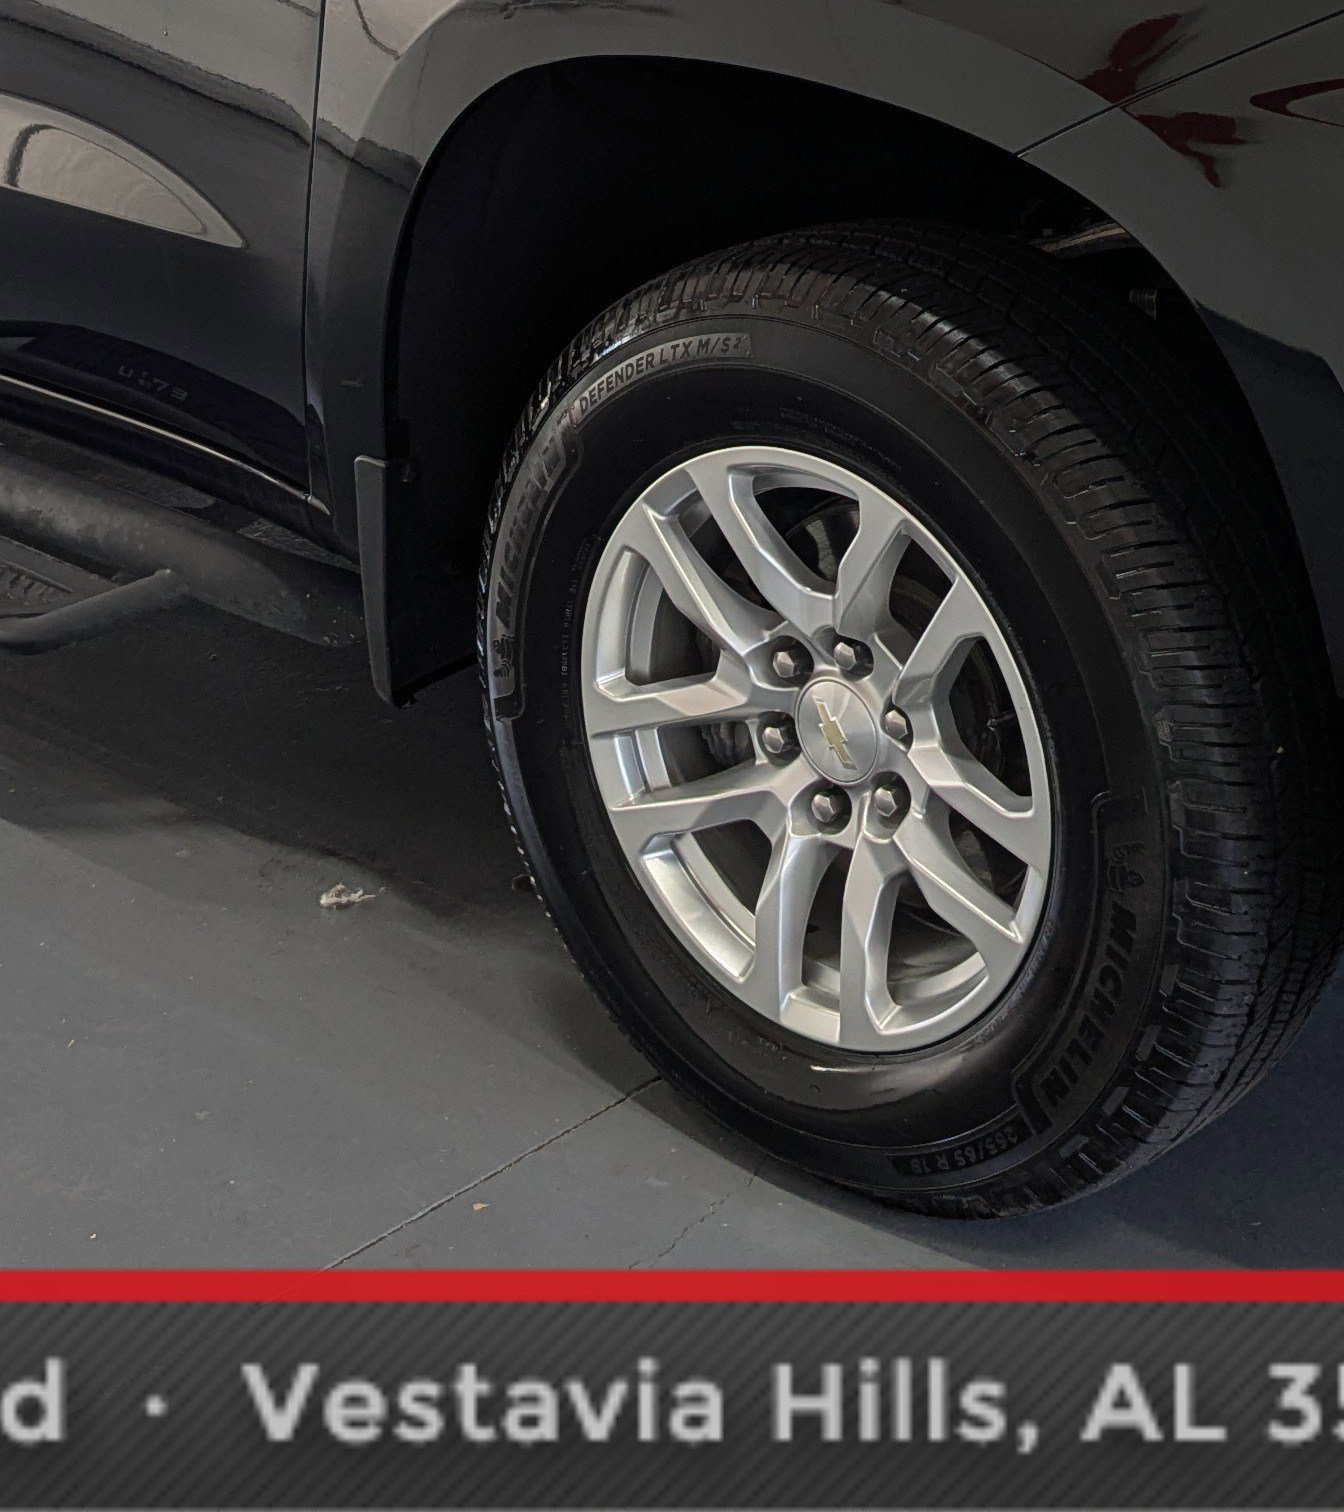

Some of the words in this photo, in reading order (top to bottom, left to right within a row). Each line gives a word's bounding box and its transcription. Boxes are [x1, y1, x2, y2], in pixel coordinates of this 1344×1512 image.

[578, 356, 656, 415] DEFENDER
[658, 340, 693, 366] LTX
[1040, 899, 1138, 1109] MICHELIN
